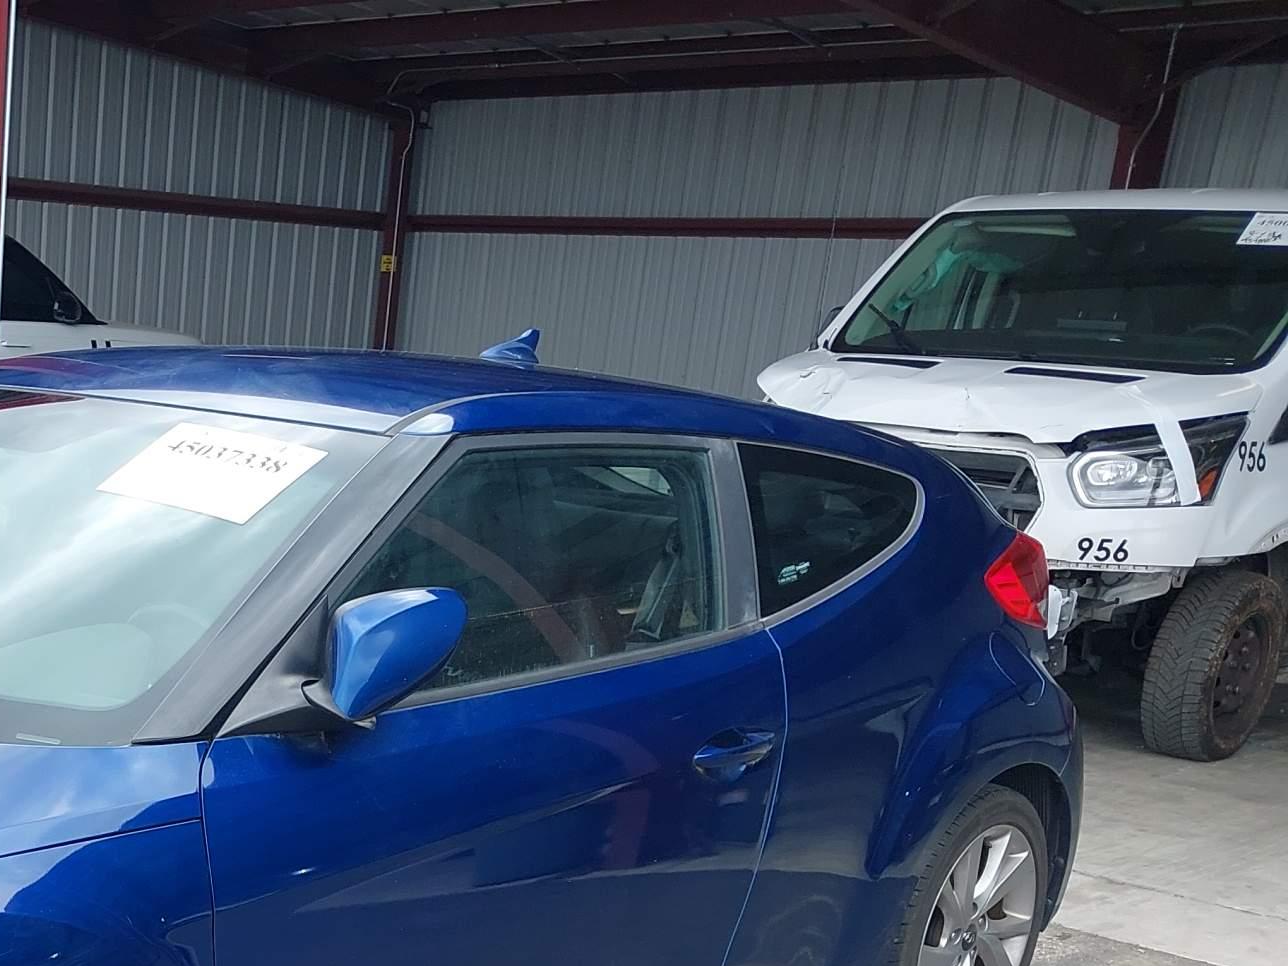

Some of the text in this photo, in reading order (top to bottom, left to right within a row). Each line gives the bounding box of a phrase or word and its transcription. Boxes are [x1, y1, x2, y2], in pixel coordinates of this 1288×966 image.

[168, 440, 288, 473] 45037338
[1238, 441, 1267, 472] 956
[1077, 538, 1129, 562] 956
